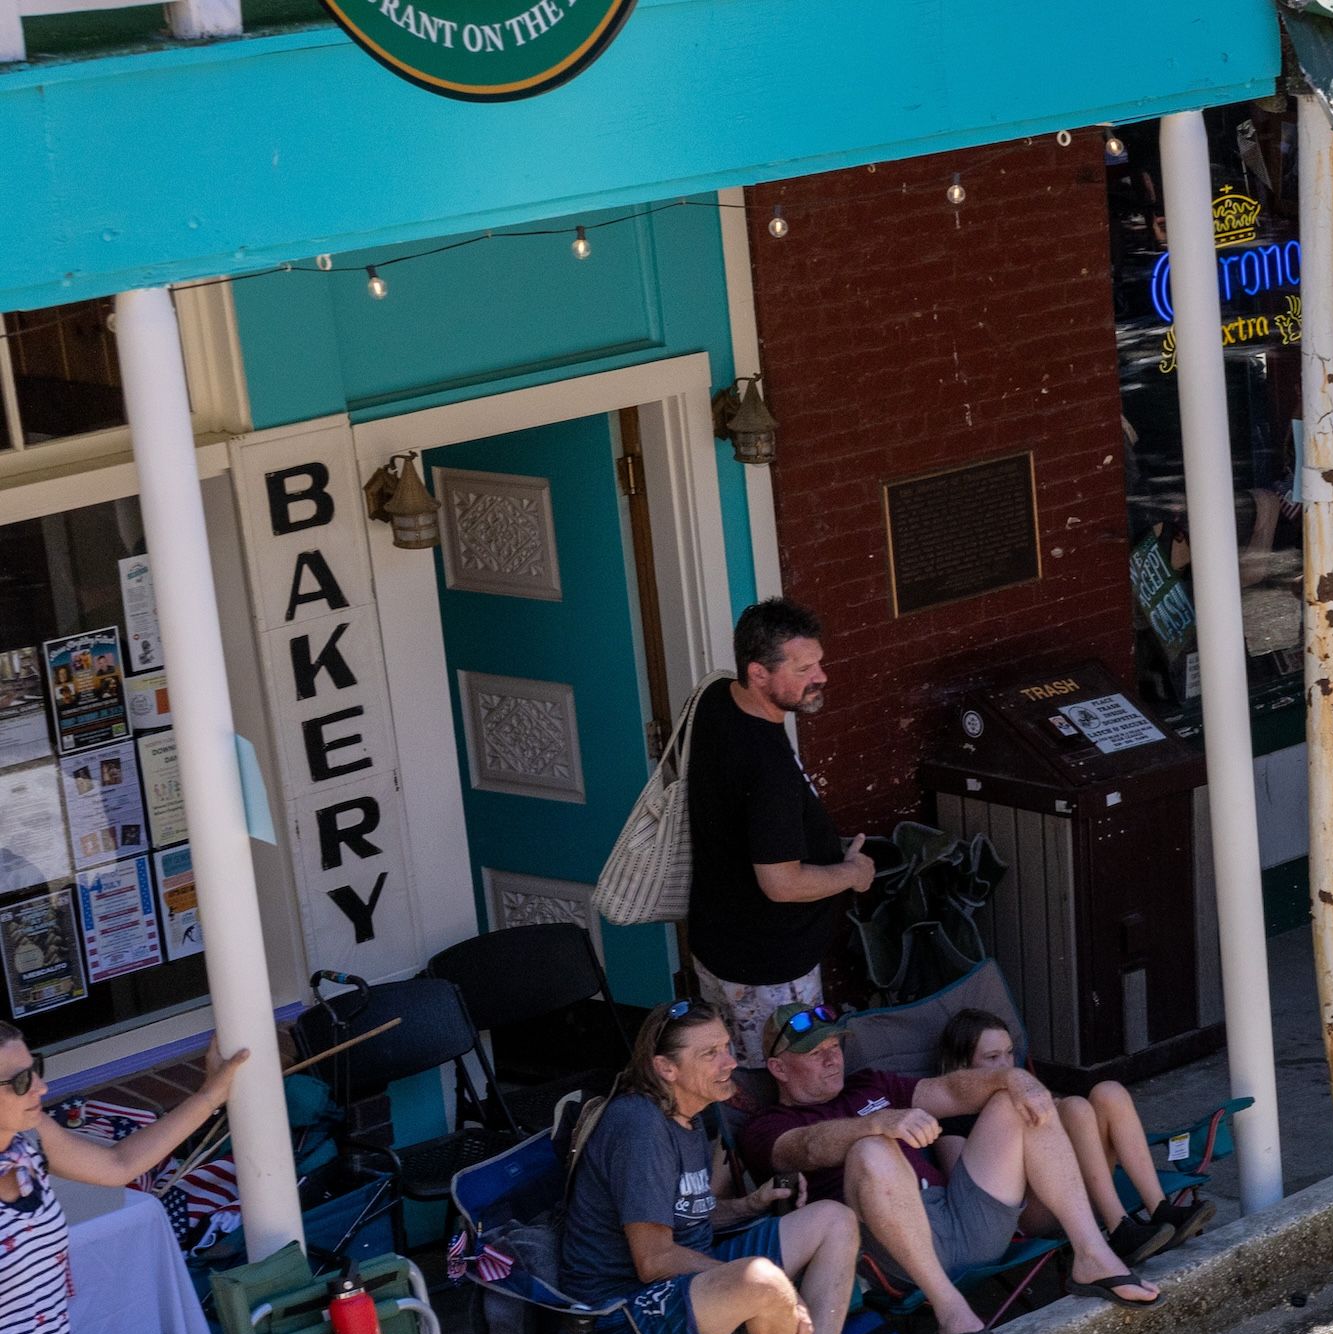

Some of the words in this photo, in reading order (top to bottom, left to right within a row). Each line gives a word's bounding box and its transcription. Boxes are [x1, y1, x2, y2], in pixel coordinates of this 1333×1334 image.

[367, 0, 458, 49] RANT
[462, 24, 504, 52] ON
[505, 2, 564, 46] THE
[1222, 317, 1269, 347] xtra
[1139, 543, 1171, 608] ACCEPT
[264, 460, 388, 944] BAKERY
[1020, 679, 1080, 701] TRASH
[1096, 703, 1121, 712] TRASH
